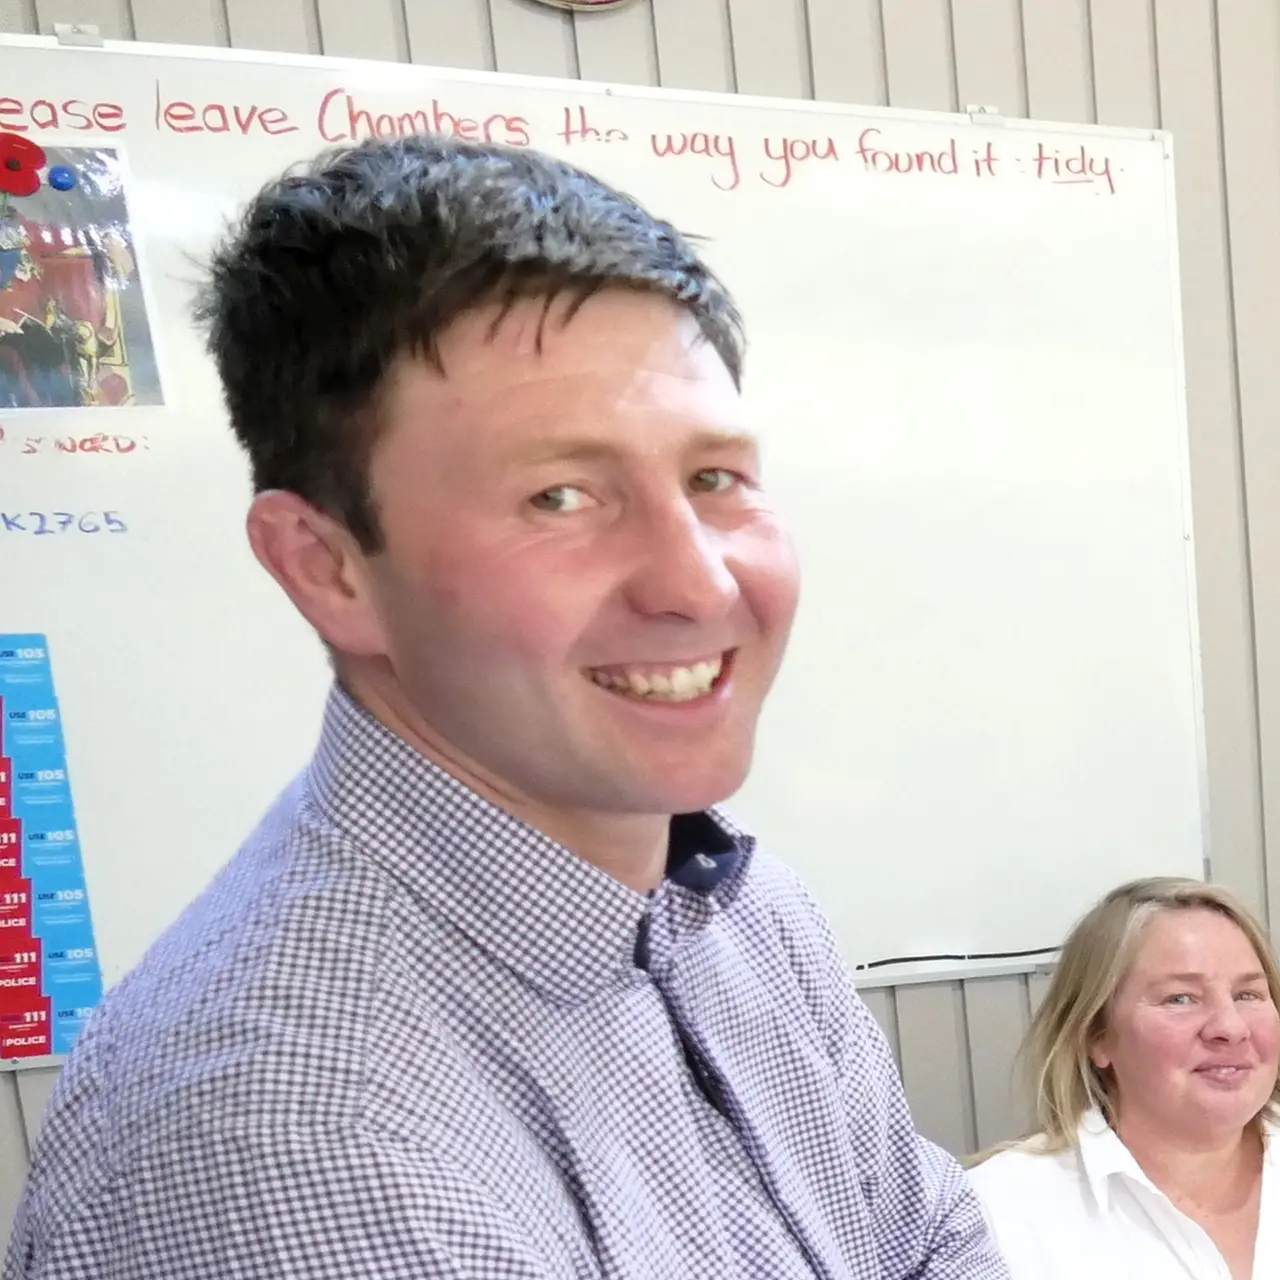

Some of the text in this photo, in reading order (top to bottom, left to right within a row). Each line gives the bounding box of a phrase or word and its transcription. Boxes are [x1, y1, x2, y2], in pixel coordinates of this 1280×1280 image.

[156, 79, 299, 134] leave
[318, 88, 530, 146] Chambers
[651, 132, 738, 190] way
[759, 135, 838, 188] you
[855, 128, 958, 176] found
[971, 140, 999, 178] it
[37, 769, 65, 781] 105
[4, 893, 26, 904] 111
[57, 889, 84, 900] 105
[14, 952, 36, 963] 111
[66, 948, 93, 959] 105
[24, 1011, 46, 1022] 111
[6, 1036, 46, 1046] POLICE
